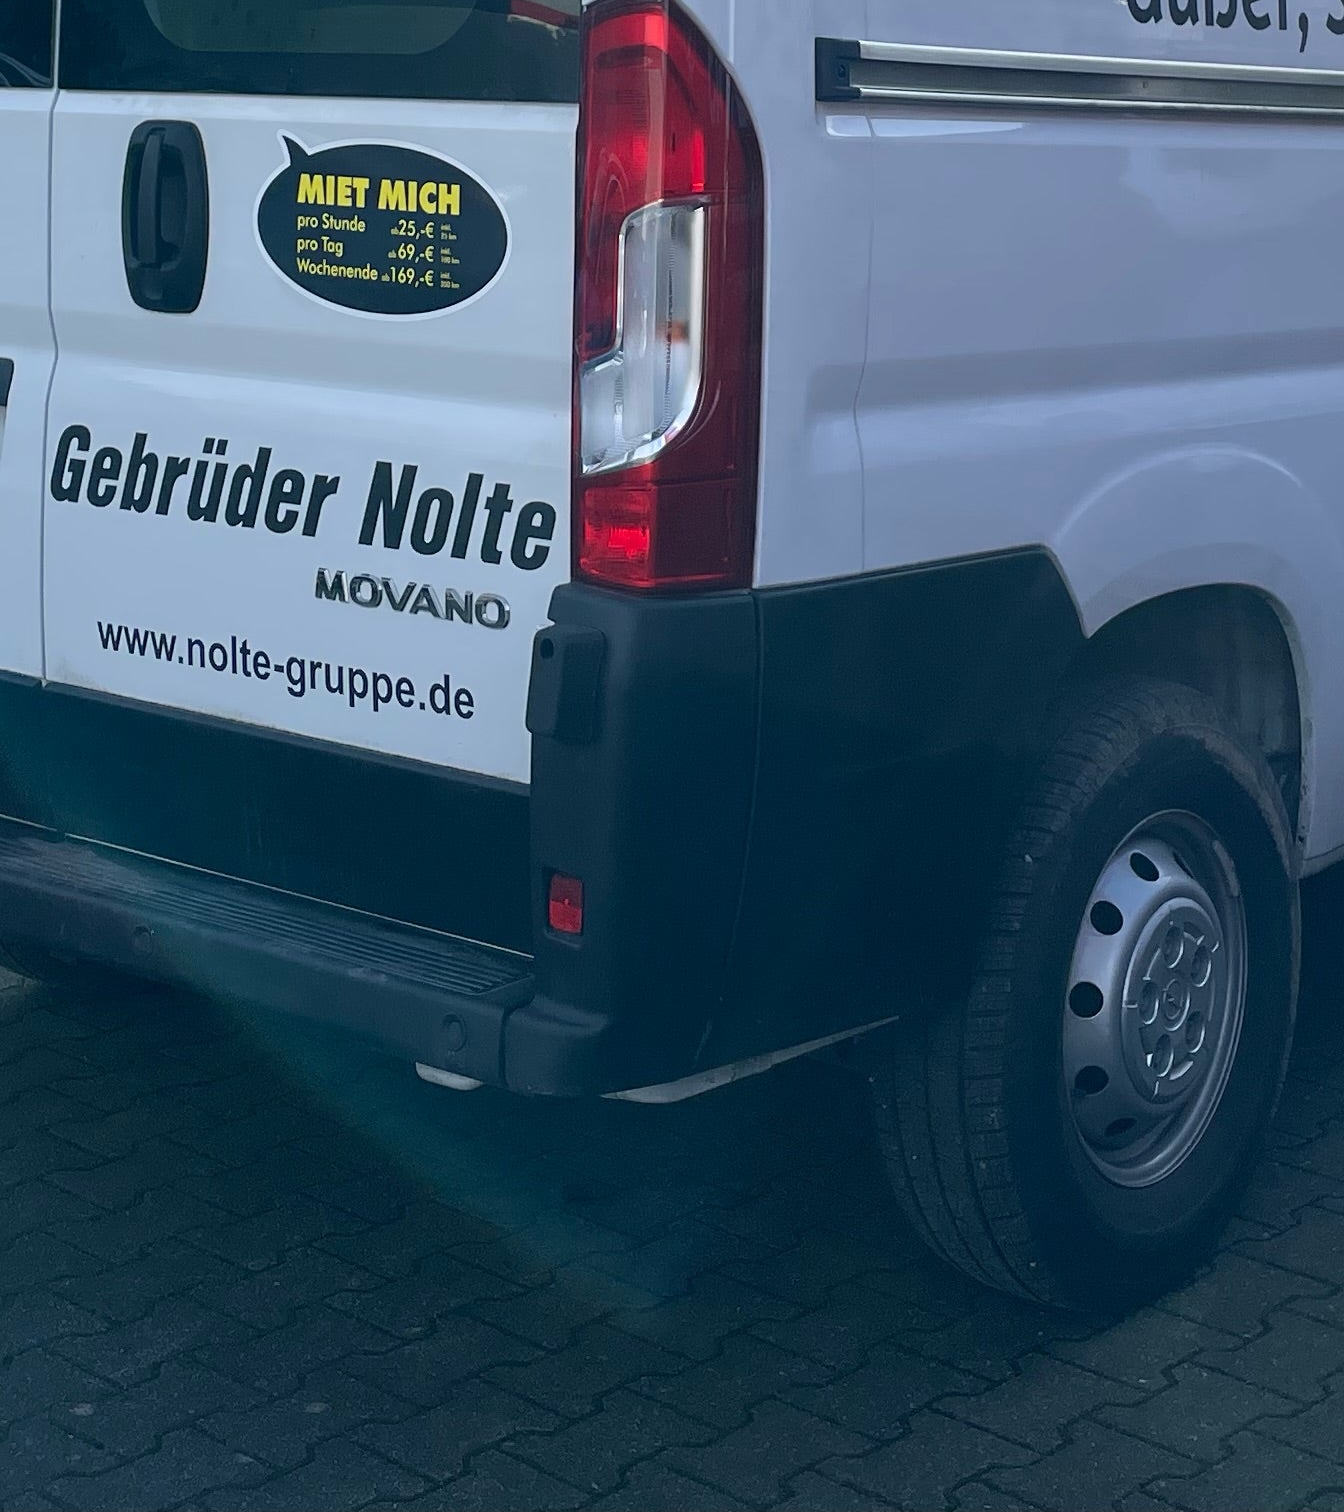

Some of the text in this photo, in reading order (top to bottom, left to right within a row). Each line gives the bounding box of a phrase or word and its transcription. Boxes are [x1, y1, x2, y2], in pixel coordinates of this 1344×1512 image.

[297, 174, 460, 216] MIET MICH
[297, 215, 319, 231] pro
[322, 213, 366, 233] Stunde
[297, 238, 319, 255] pro
[321, 236, 344, 257] Tag
[296, 257, 378, 281] Wochenende
[50, 424, 557, 571] Gebrüder Nolte
[314, 567, 511, 630] MOVANO
[97, 620, 475, 719] www.nolte-gruppe.de
